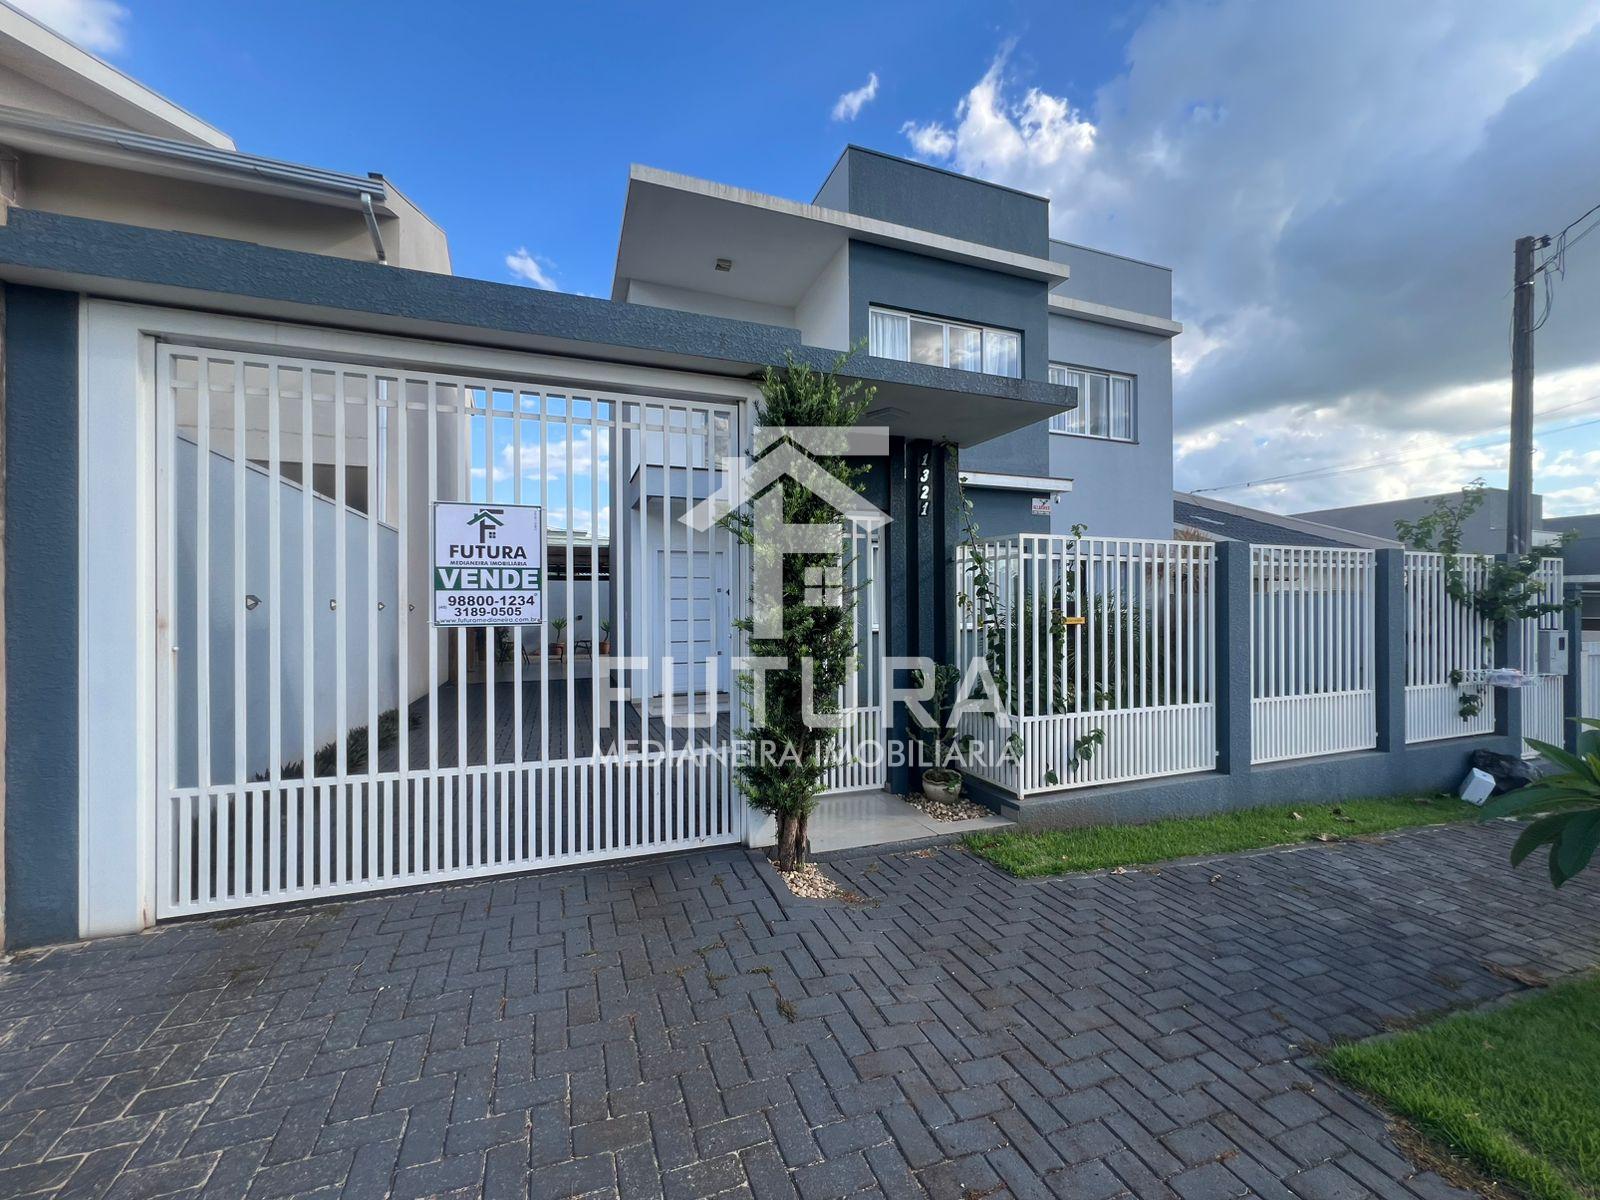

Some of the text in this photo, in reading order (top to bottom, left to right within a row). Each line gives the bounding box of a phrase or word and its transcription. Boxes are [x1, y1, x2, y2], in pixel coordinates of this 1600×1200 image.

[920, 453, 930, 516] 1321
[449, 544, 527, 559] FUTURA
[438, 568, 539, 589] VENDE
[448, 595, 535, 606] 98800-1234
[454, 607, 522, 617] 3189-0505
